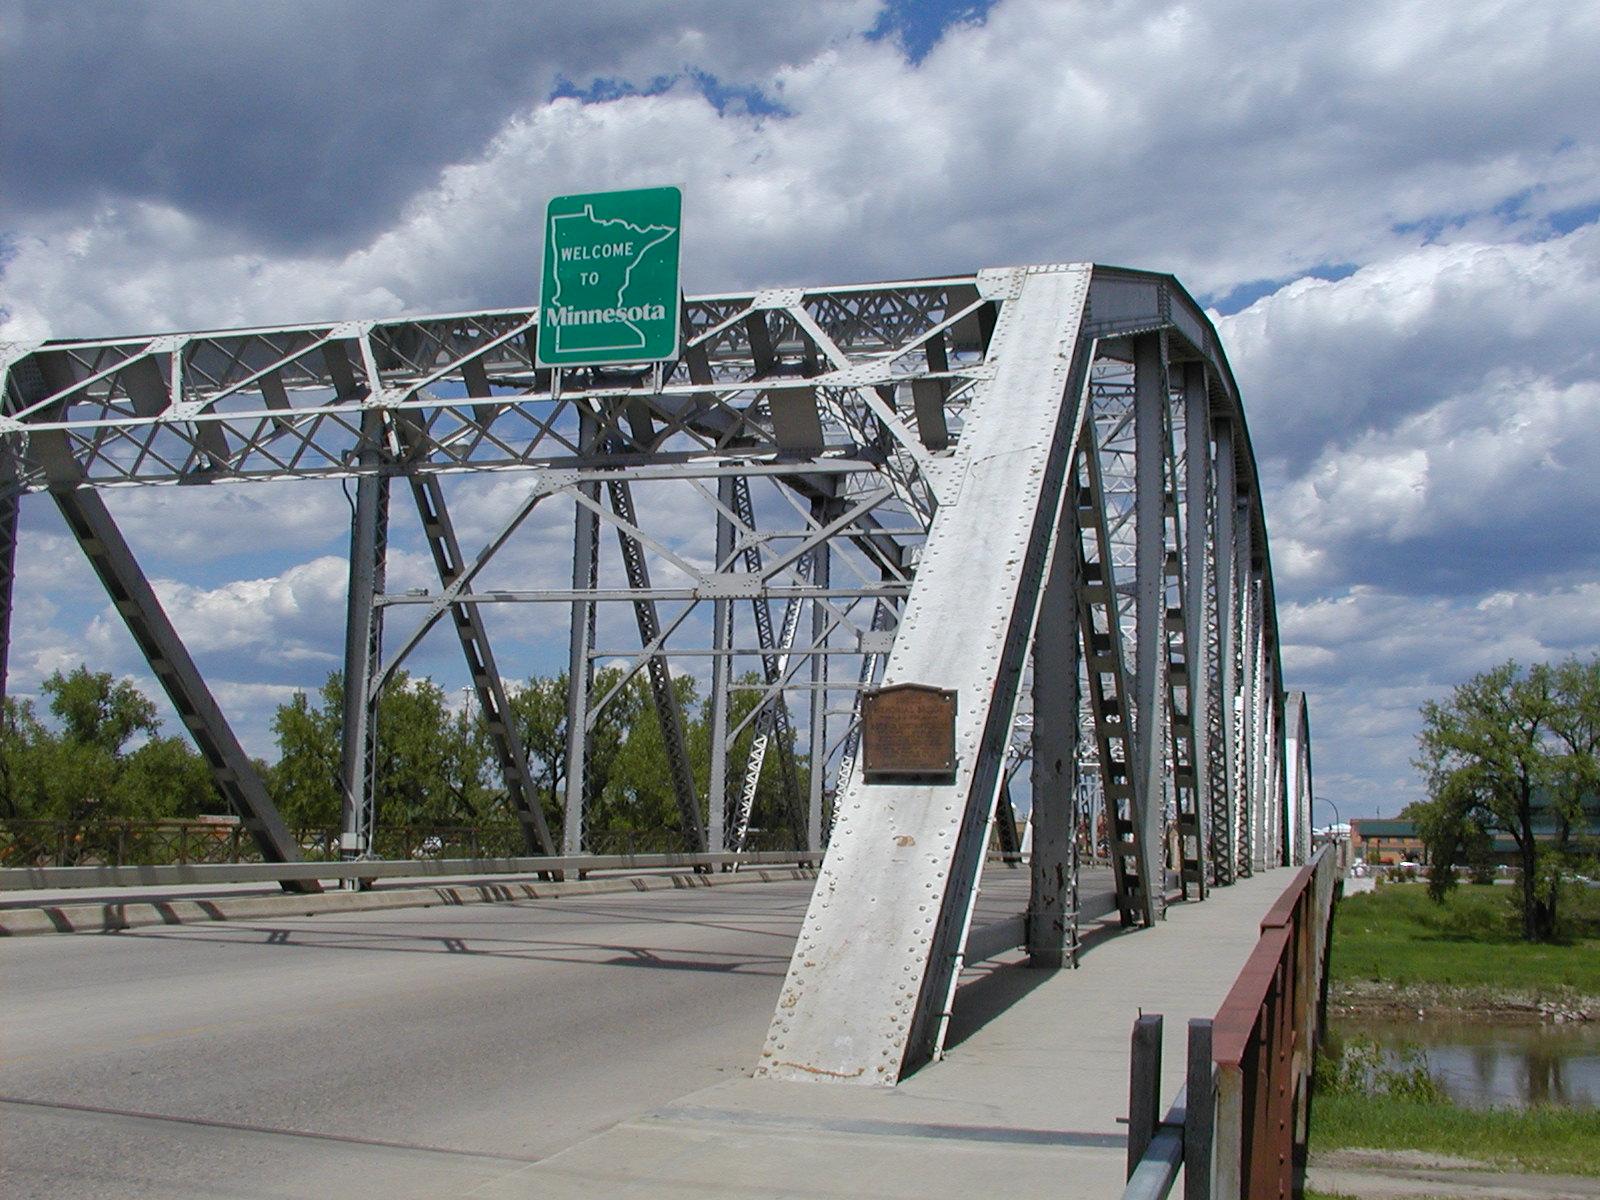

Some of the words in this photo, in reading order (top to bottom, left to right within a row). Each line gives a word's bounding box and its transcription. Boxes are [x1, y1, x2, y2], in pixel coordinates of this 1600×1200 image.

[561, 242, 633, 261] WELCOME
[580, 272, 598, 285] TO
[546, 303, 665, 327] Minnesota
